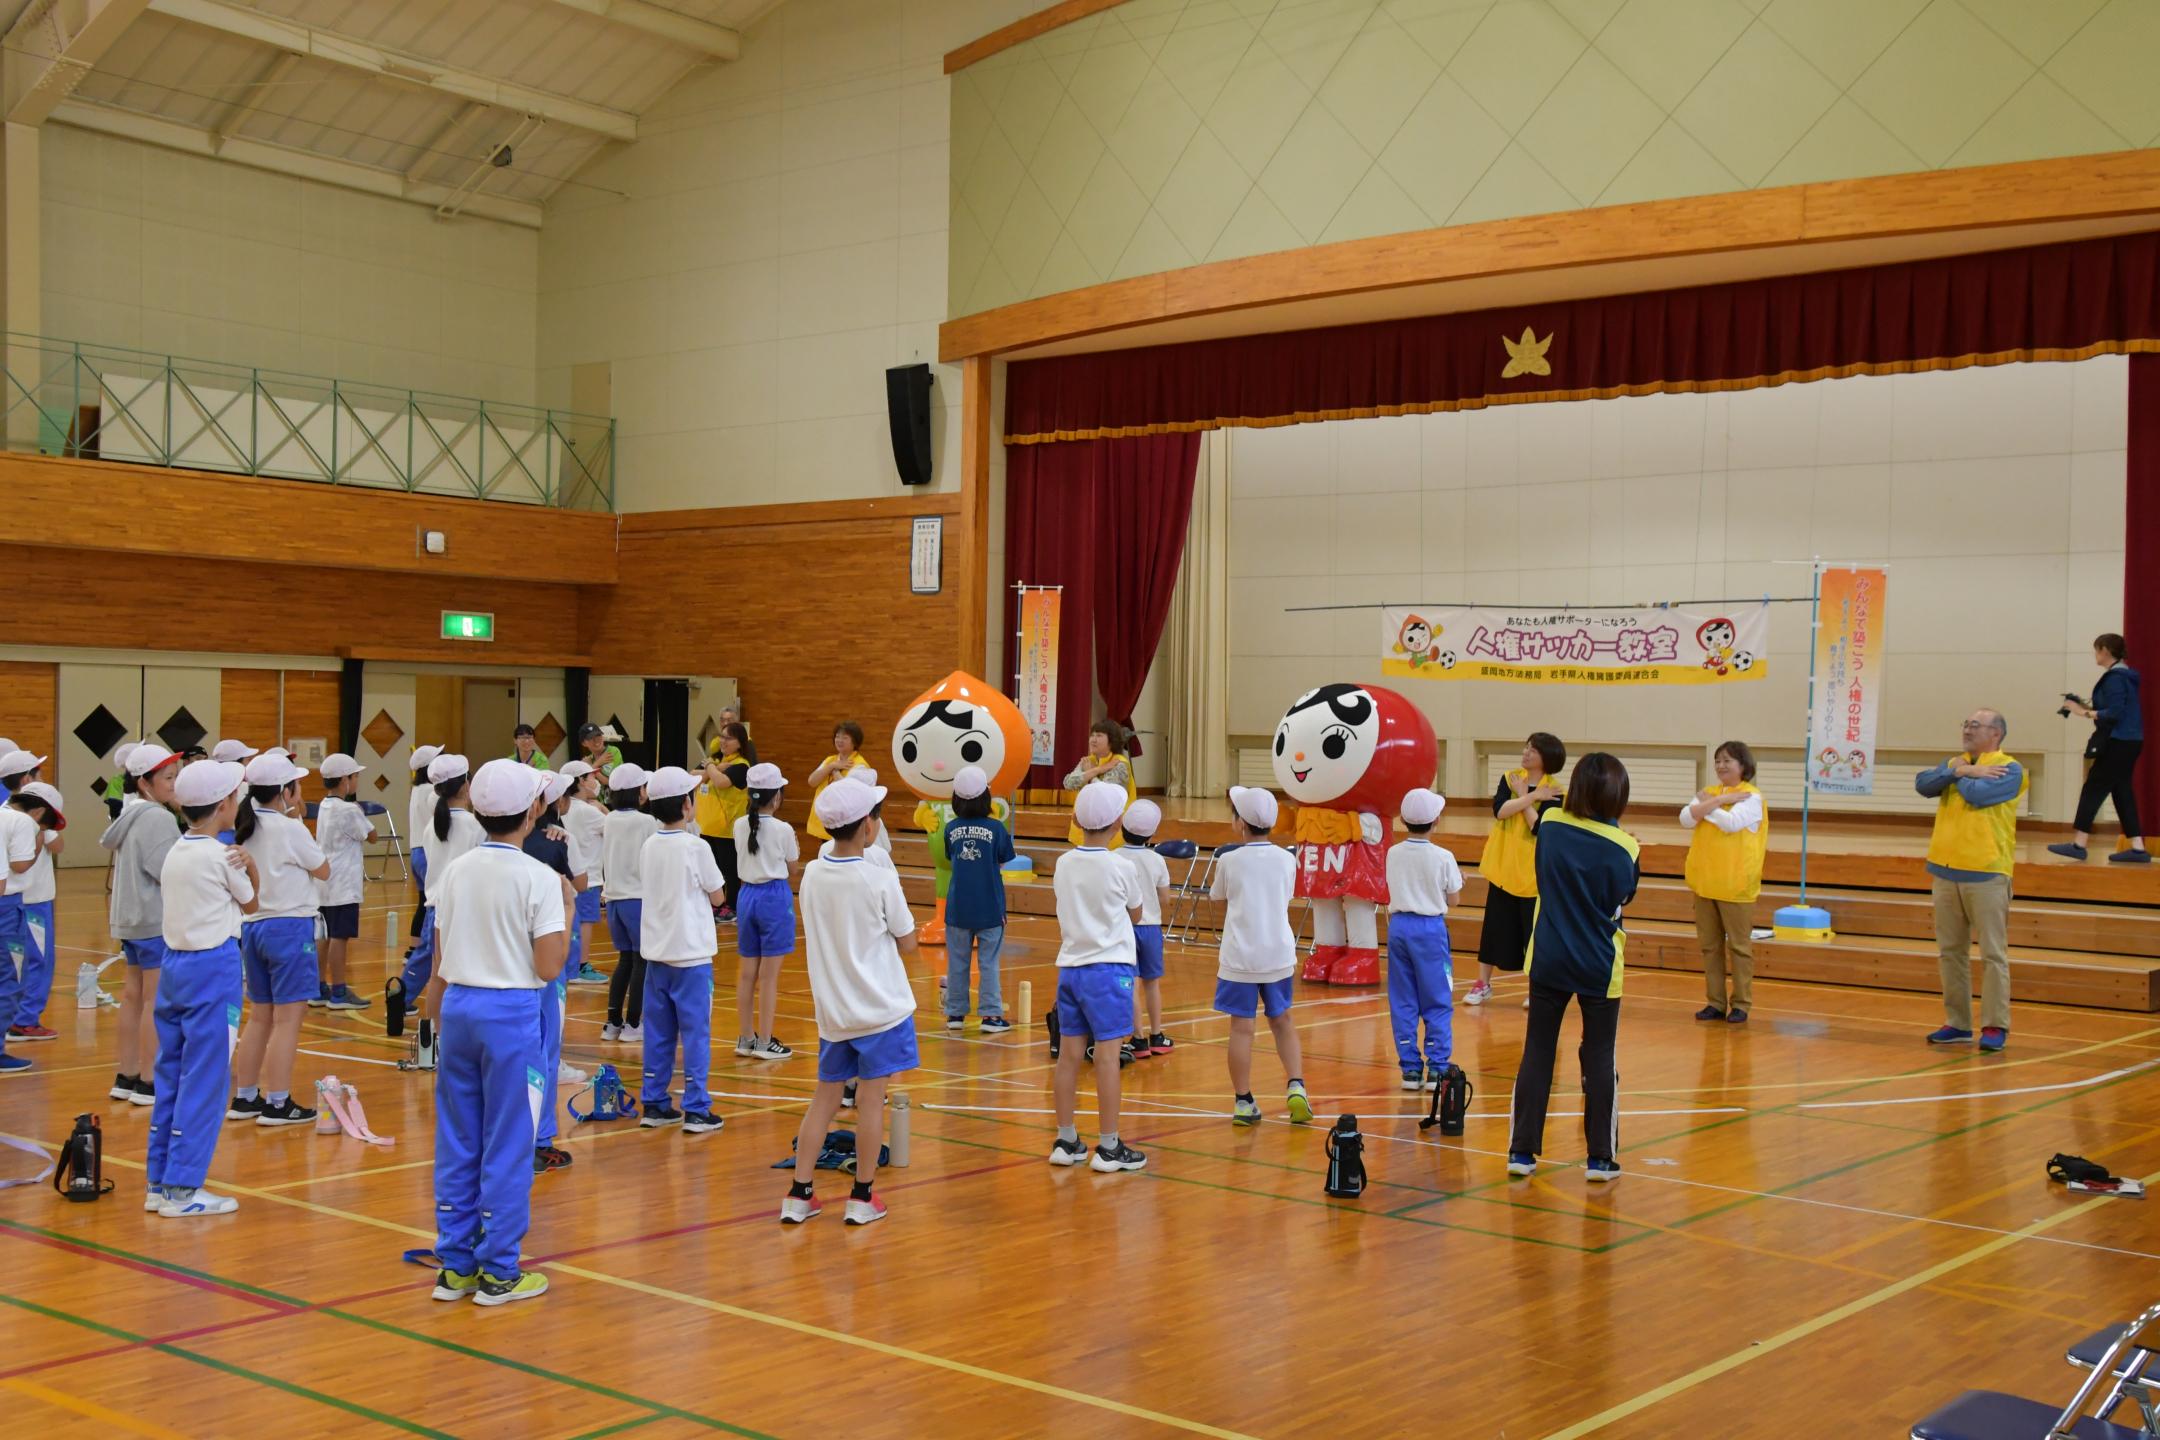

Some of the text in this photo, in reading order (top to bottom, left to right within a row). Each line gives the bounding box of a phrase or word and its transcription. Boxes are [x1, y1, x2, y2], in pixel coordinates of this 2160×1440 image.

[1506, 615, 1638, 626] あなたも人権サポーターになろう
[1466, 625, 1679, 663] 人権サッカー教室
[1846, 676, 1863, 742] 人権の世紀
[949, 826, 967, 841] JUST
[968, 826, 993, 840] HOOPS
